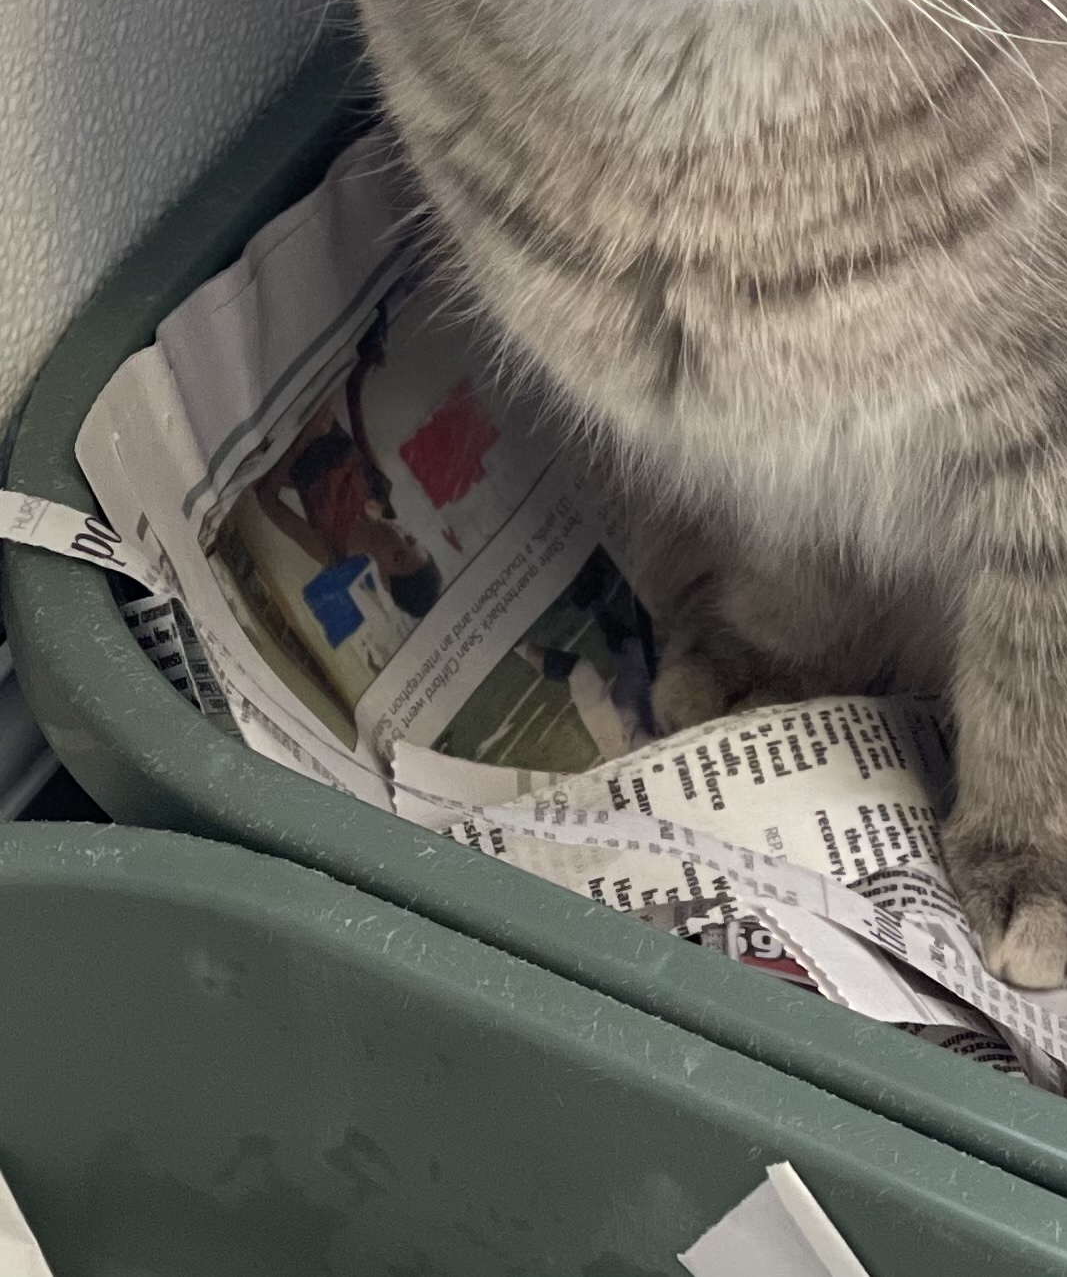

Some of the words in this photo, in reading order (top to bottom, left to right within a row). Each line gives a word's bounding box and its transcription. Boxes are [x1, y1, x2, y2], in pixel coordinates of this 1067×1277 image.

[467, 551, 529, 617] touchdown
[476, 562, 543, 633] quarterback
[436, 632, 456, 653] an
[449, 611, 476, 638] and
[453, 627, 485, 661] Sean
[382, 648, 446, 716] interception
[418, 655, 464, 703] Clifford
[398, 696, 430, 729] went
[818, 708, 840, 746] from
[741, 743, 767, 786] more
[764, 738, 792, 779] local
[785, 731, 813, 773] need
[810, 738, 831, 767] the
[837, 714, 871, 782] requests
[488, 826, 507, 855] tax
[761, 824, 785, 854] REP.
[811, 808, 848, 884] recovery.
[842, 825, 866, 855] the
[876, 801, 892, 823] on
[884, 823, 904, 851] the
[892, 800, 922, 861] ranking
